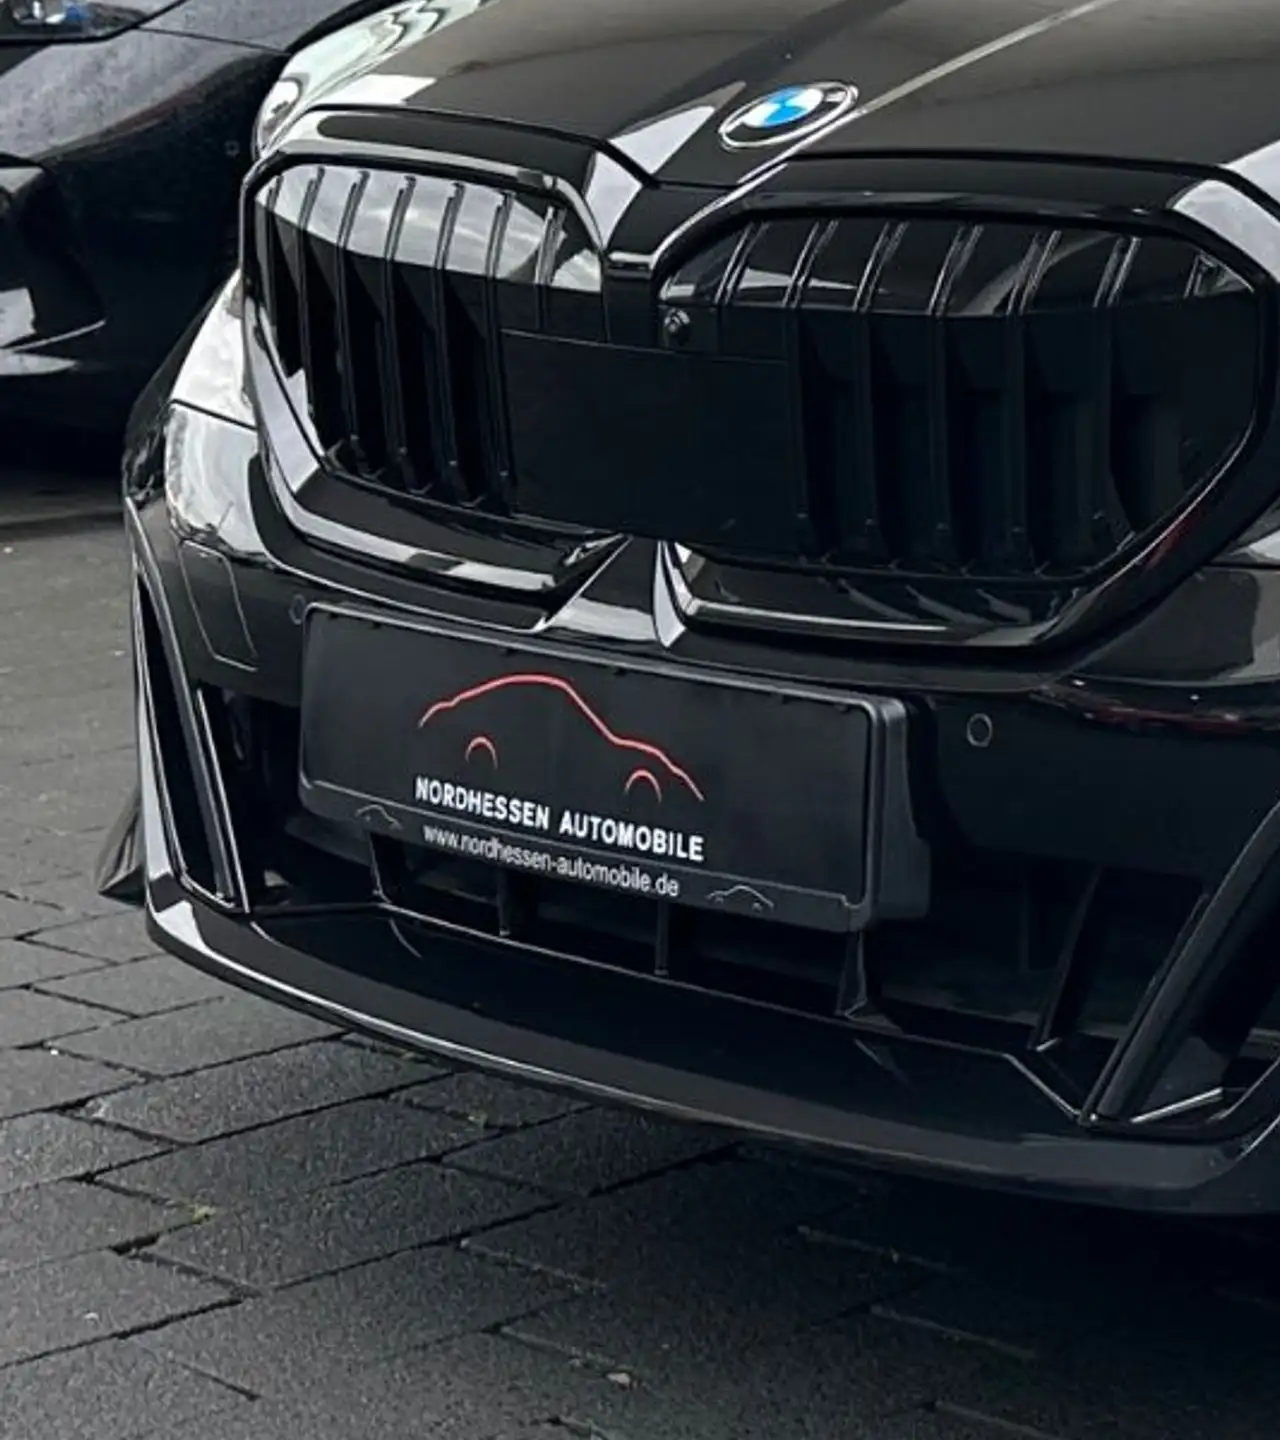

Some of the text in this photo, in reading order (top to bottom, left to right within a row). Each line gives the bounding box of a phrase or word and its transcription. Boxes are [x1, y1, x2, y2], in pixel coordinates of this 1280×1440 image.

[415, 775, 705, 862] NORDHESSEN AUTOMOBILE
[422, 824, 680, 897] www.nordhessen-automobile.de
